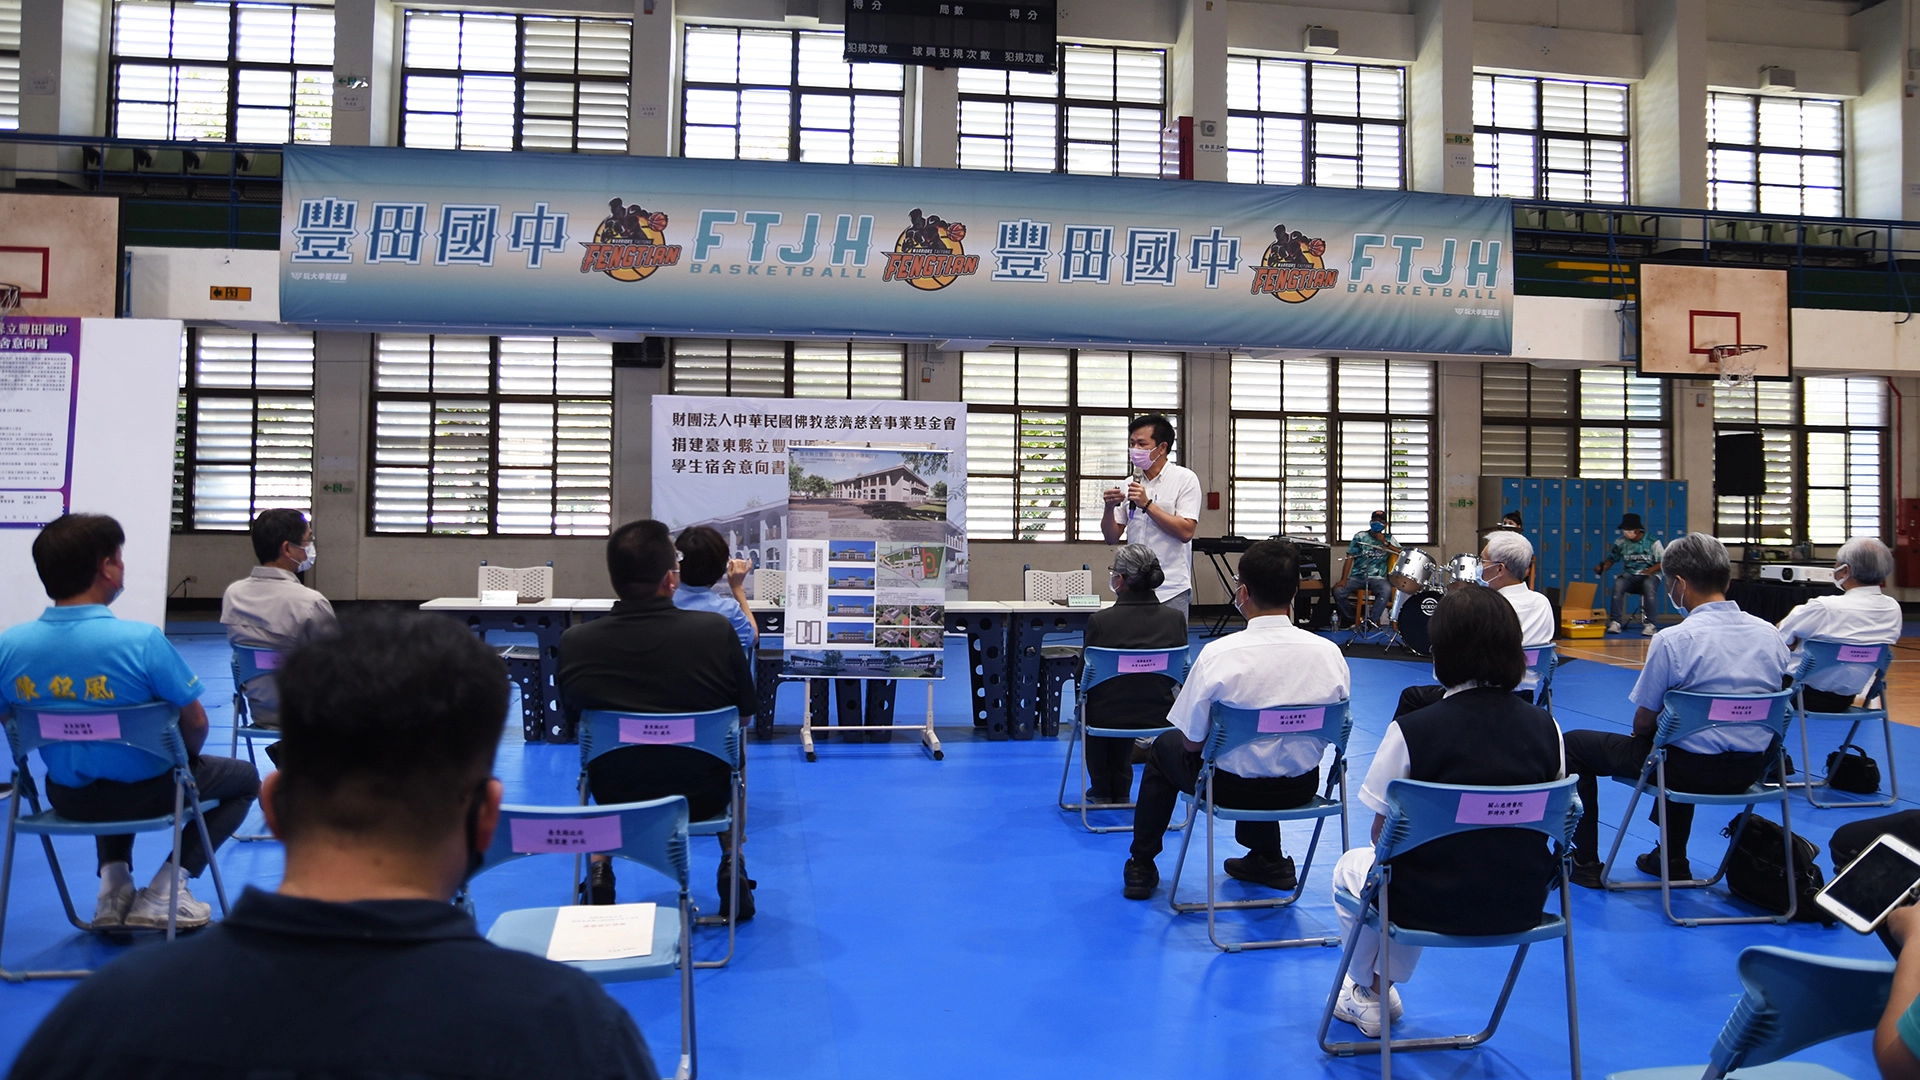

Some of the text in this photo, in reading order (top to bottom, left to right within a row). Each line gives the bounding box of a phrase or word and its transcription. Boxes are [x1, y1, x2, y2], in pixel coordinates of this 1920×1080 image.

[939, 4, 964, 16] 局數
[1009, 8, 1038, 20] 得分
[847, 42, 888, 55] 犯規次數
[912, 46, 991, 61] 球員犯規次數
[1004, 51, 1045, 64] 犯規次數
[291, 196, 570, 269] 豐田國中
[691, 209, 874, 268] FTJH
[578, 242, 682, 273] FENGTIAN
[991, 218, 1243, 289] 豐田國中
[1348, 233, 1503, 290] FTJH
[690, 263, 866, 278] BASKETBALL
[880, 251, 980, 282] FENGTIAN
[1248, 265, 1339, 295] FENGTIAN
[1347, 283, 1497, 299] BASKETBALL
[672, 412, 957, 431] 財團法人中華民國佛教慈濟慈善事業基金會
[672, 437, 834, 453] 捐建臺東縣立豐
[671, 458, 786, 475] 學生宿舍意向書
